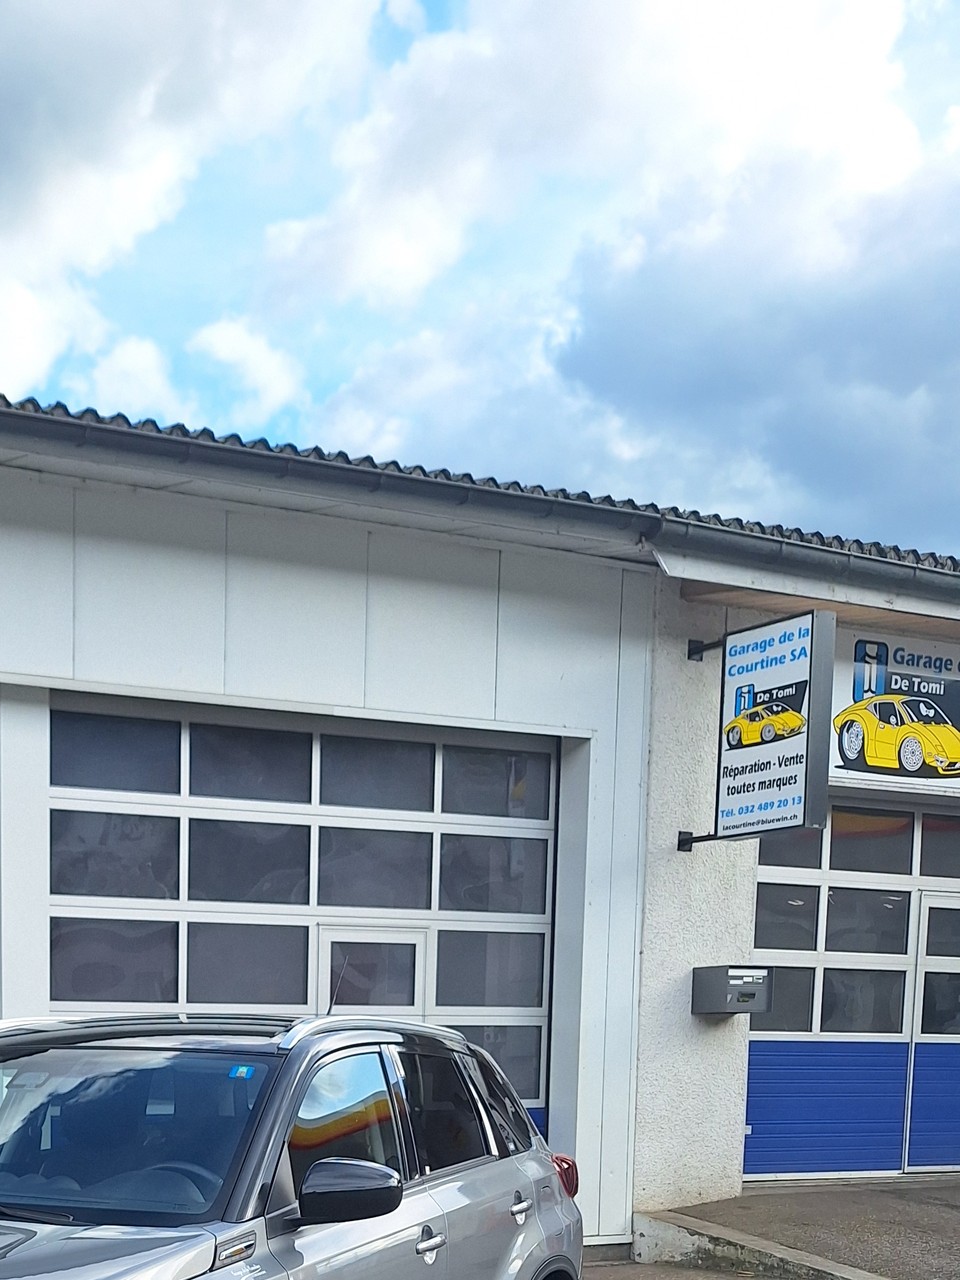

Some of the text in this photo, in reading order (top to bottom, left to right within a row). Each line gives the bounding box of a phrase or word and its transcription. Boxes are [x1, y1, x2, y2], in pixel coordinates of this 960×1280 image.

[728, 627, 810, 657] Garage de la
[728, 646, 808, 677] Courtine SA
[892, 646, 953, 674] Garage
[756, 684, 796, 703] De Tomi
[890, 674, 945, 695] De Tomi
[722, 759, 771, 781] Réparation
[777, 753, 804, 769] Vente
[726, 774, 798, 797] toutes marques
[720, 795, 802, 819] Tél. 032 489 20 13
[722, 814, 798, 831] lacourtine@bluewin.ch
